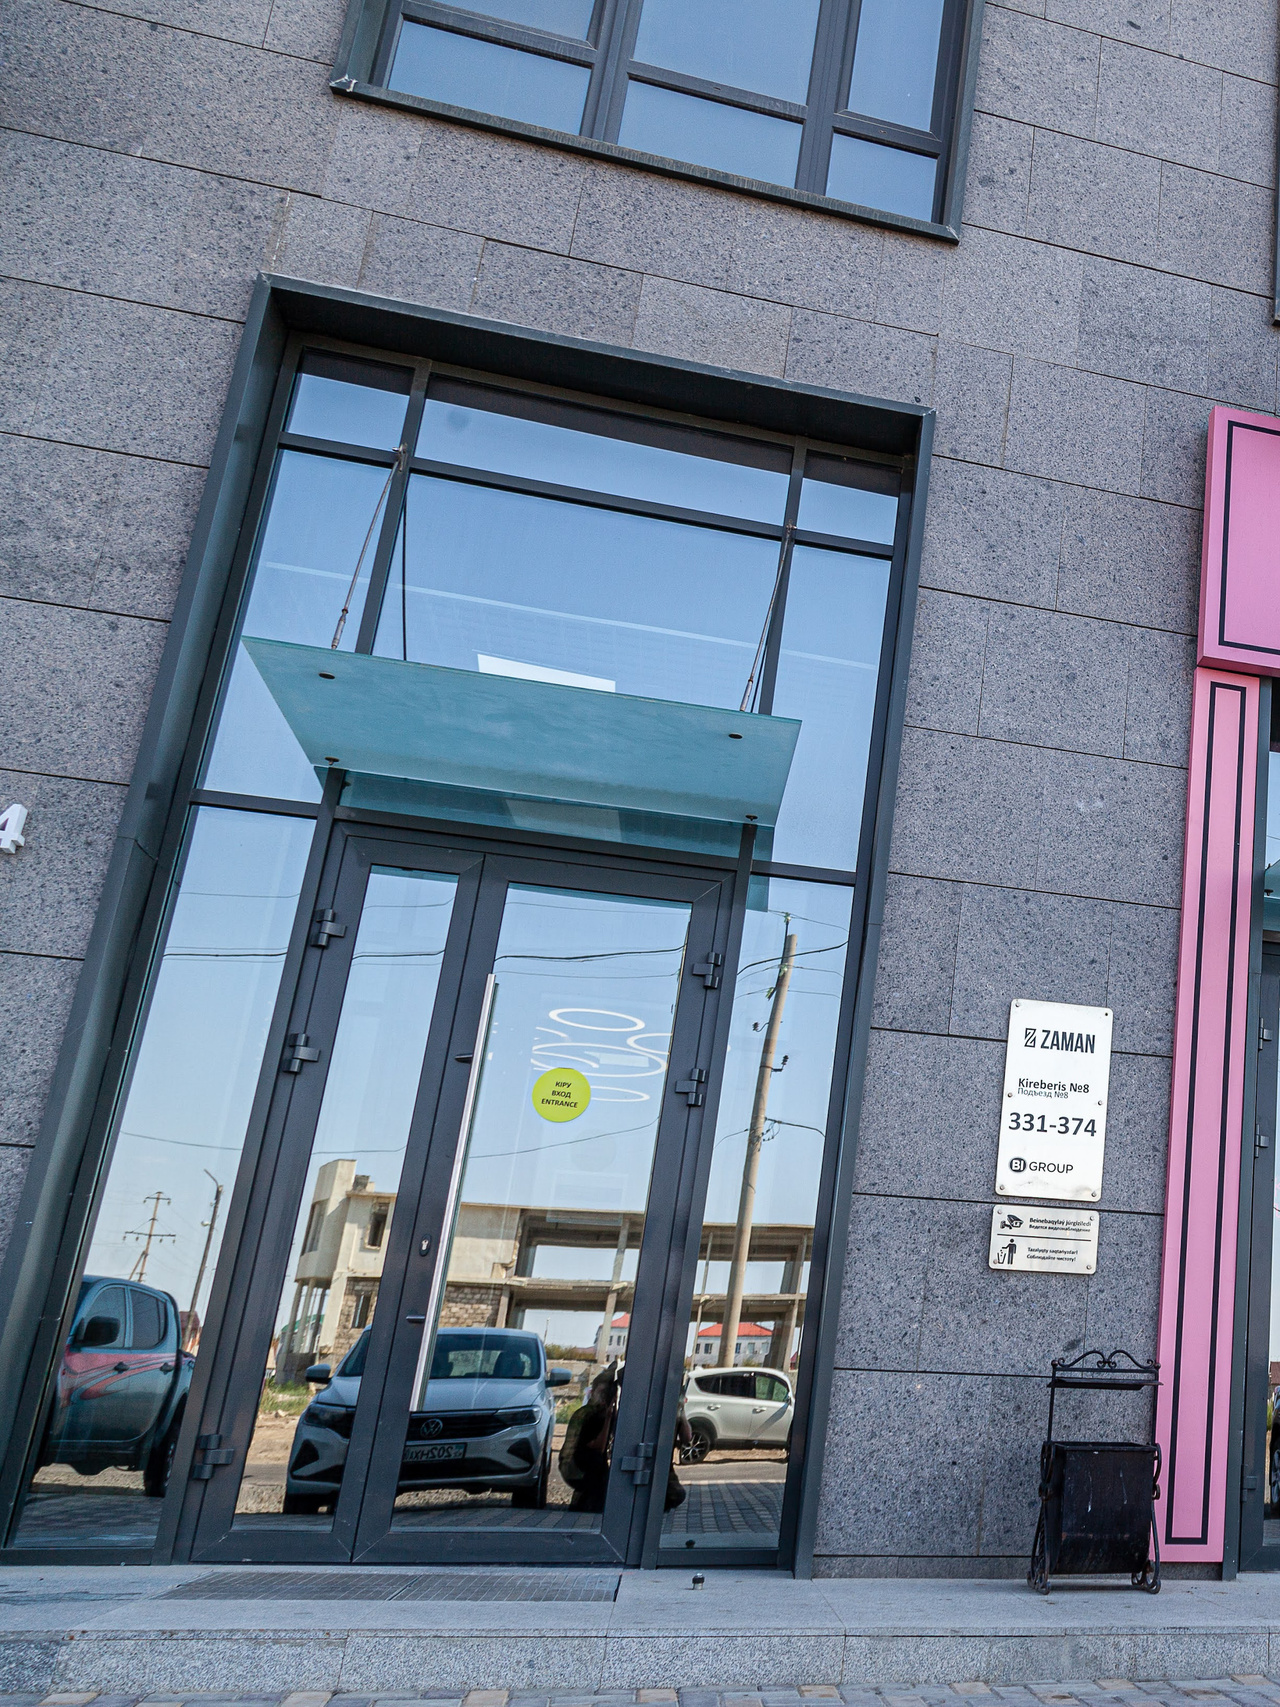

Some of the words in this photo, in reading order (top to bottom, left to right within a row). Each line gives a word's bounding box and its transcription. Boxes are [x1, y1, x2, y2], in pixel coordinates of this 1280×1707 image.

[1040, 1029, 1096, 1053] ZAMAN
[1018, 1077, 1067, 1092] Kireberis
[551, 1089, 572, 1099] ВХОД
[1017, 1087, 1053, 1099] Подъезд
[541, 1098, 578, 1108] ENTRANCE
[1008, 1112, 1097, 1137] 331-374
[1010, 1158, 1026, 1172] BI
[1029, 1161, 1074, 1173] GROUP
